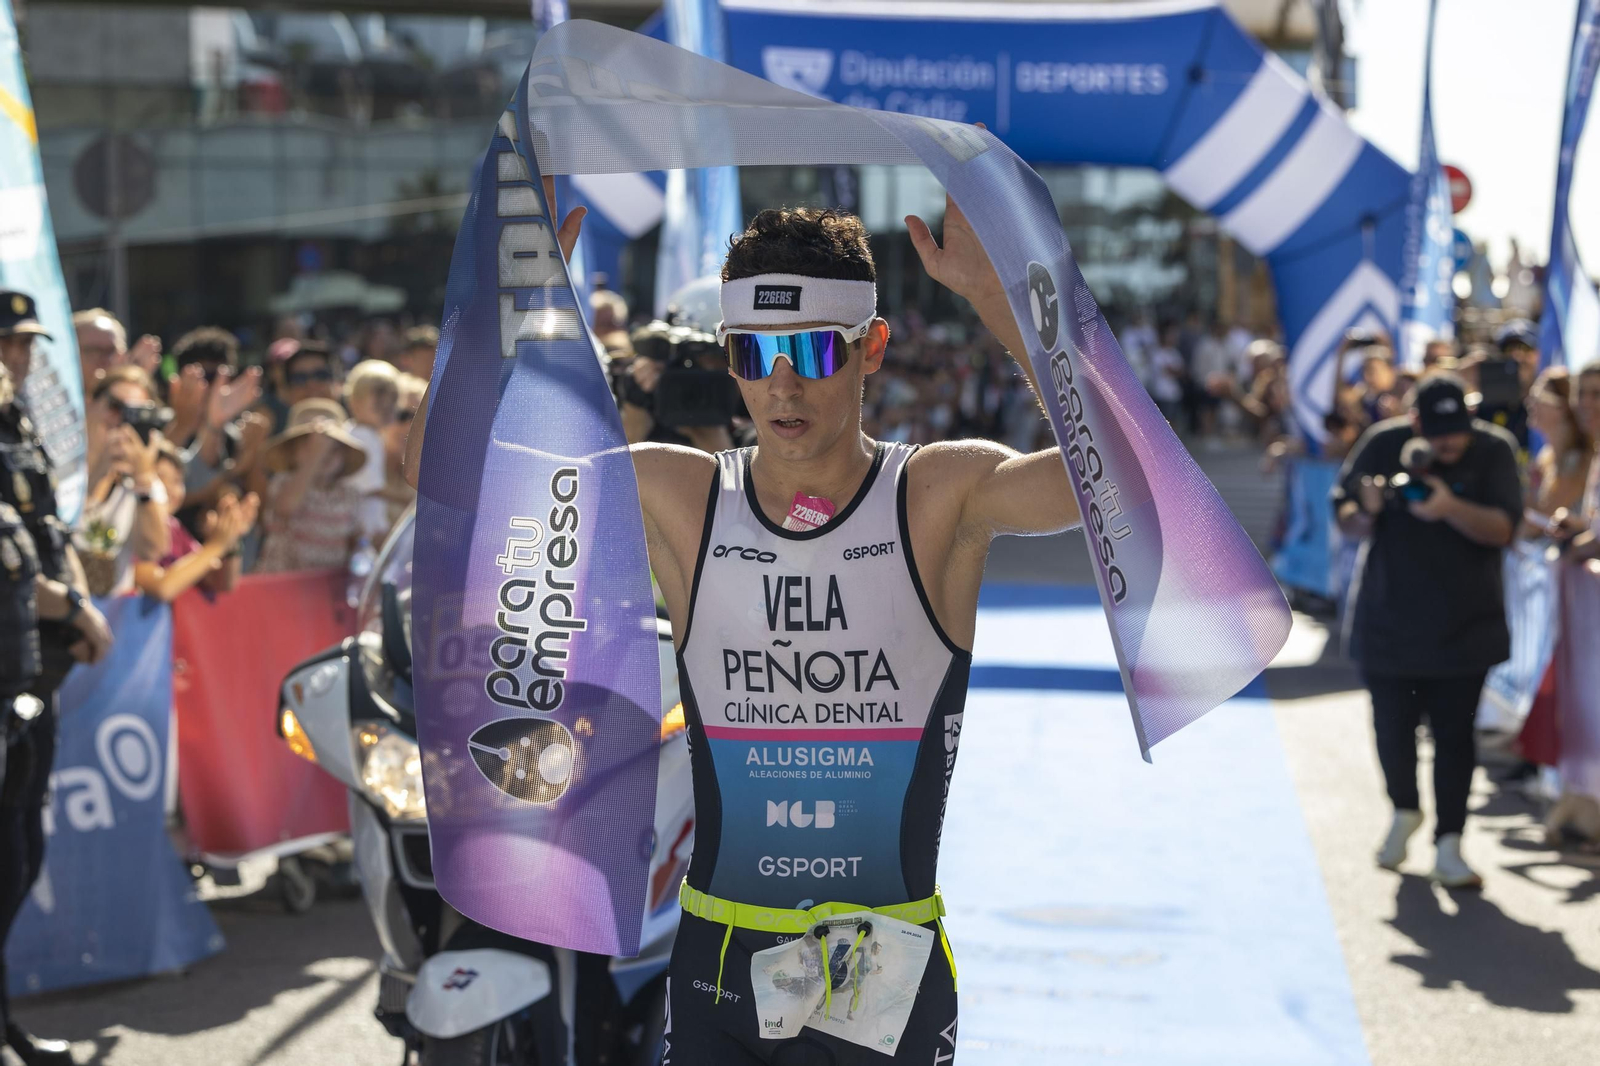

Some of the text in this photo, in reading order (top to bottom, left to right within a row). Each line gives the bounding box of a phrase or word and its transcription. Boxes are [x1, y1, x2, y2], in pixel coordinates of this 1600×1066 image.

[1016, 61, 1169, 95] DEPORTES
[758, 291, 793, 305] 226ERS
[1051, 355, 1128, 605] empresa
[792, 504, 830, 527] 226ERS
[713, 544, 777, 564] orca
[843, 541, 895, 560] GSPORT
[526, 466, 588, 712] empresa
[763, 574, 848, 632] VELA
[486, 577, 537, 709] para
[723, 639, 900, 693] PEÑOTA
[724, 697, 903, 724] CLÍNICA DENTAL
[746, 747, 874, 766] ALUSIGMA
[749, 770, 871, 779] ALEACIONES DE ALUMINIO
[758, 856, 862, 878] GSPORT
[692, 979, 741, 1003] GSPORT
[765, 1016, 783, 1028] imd
